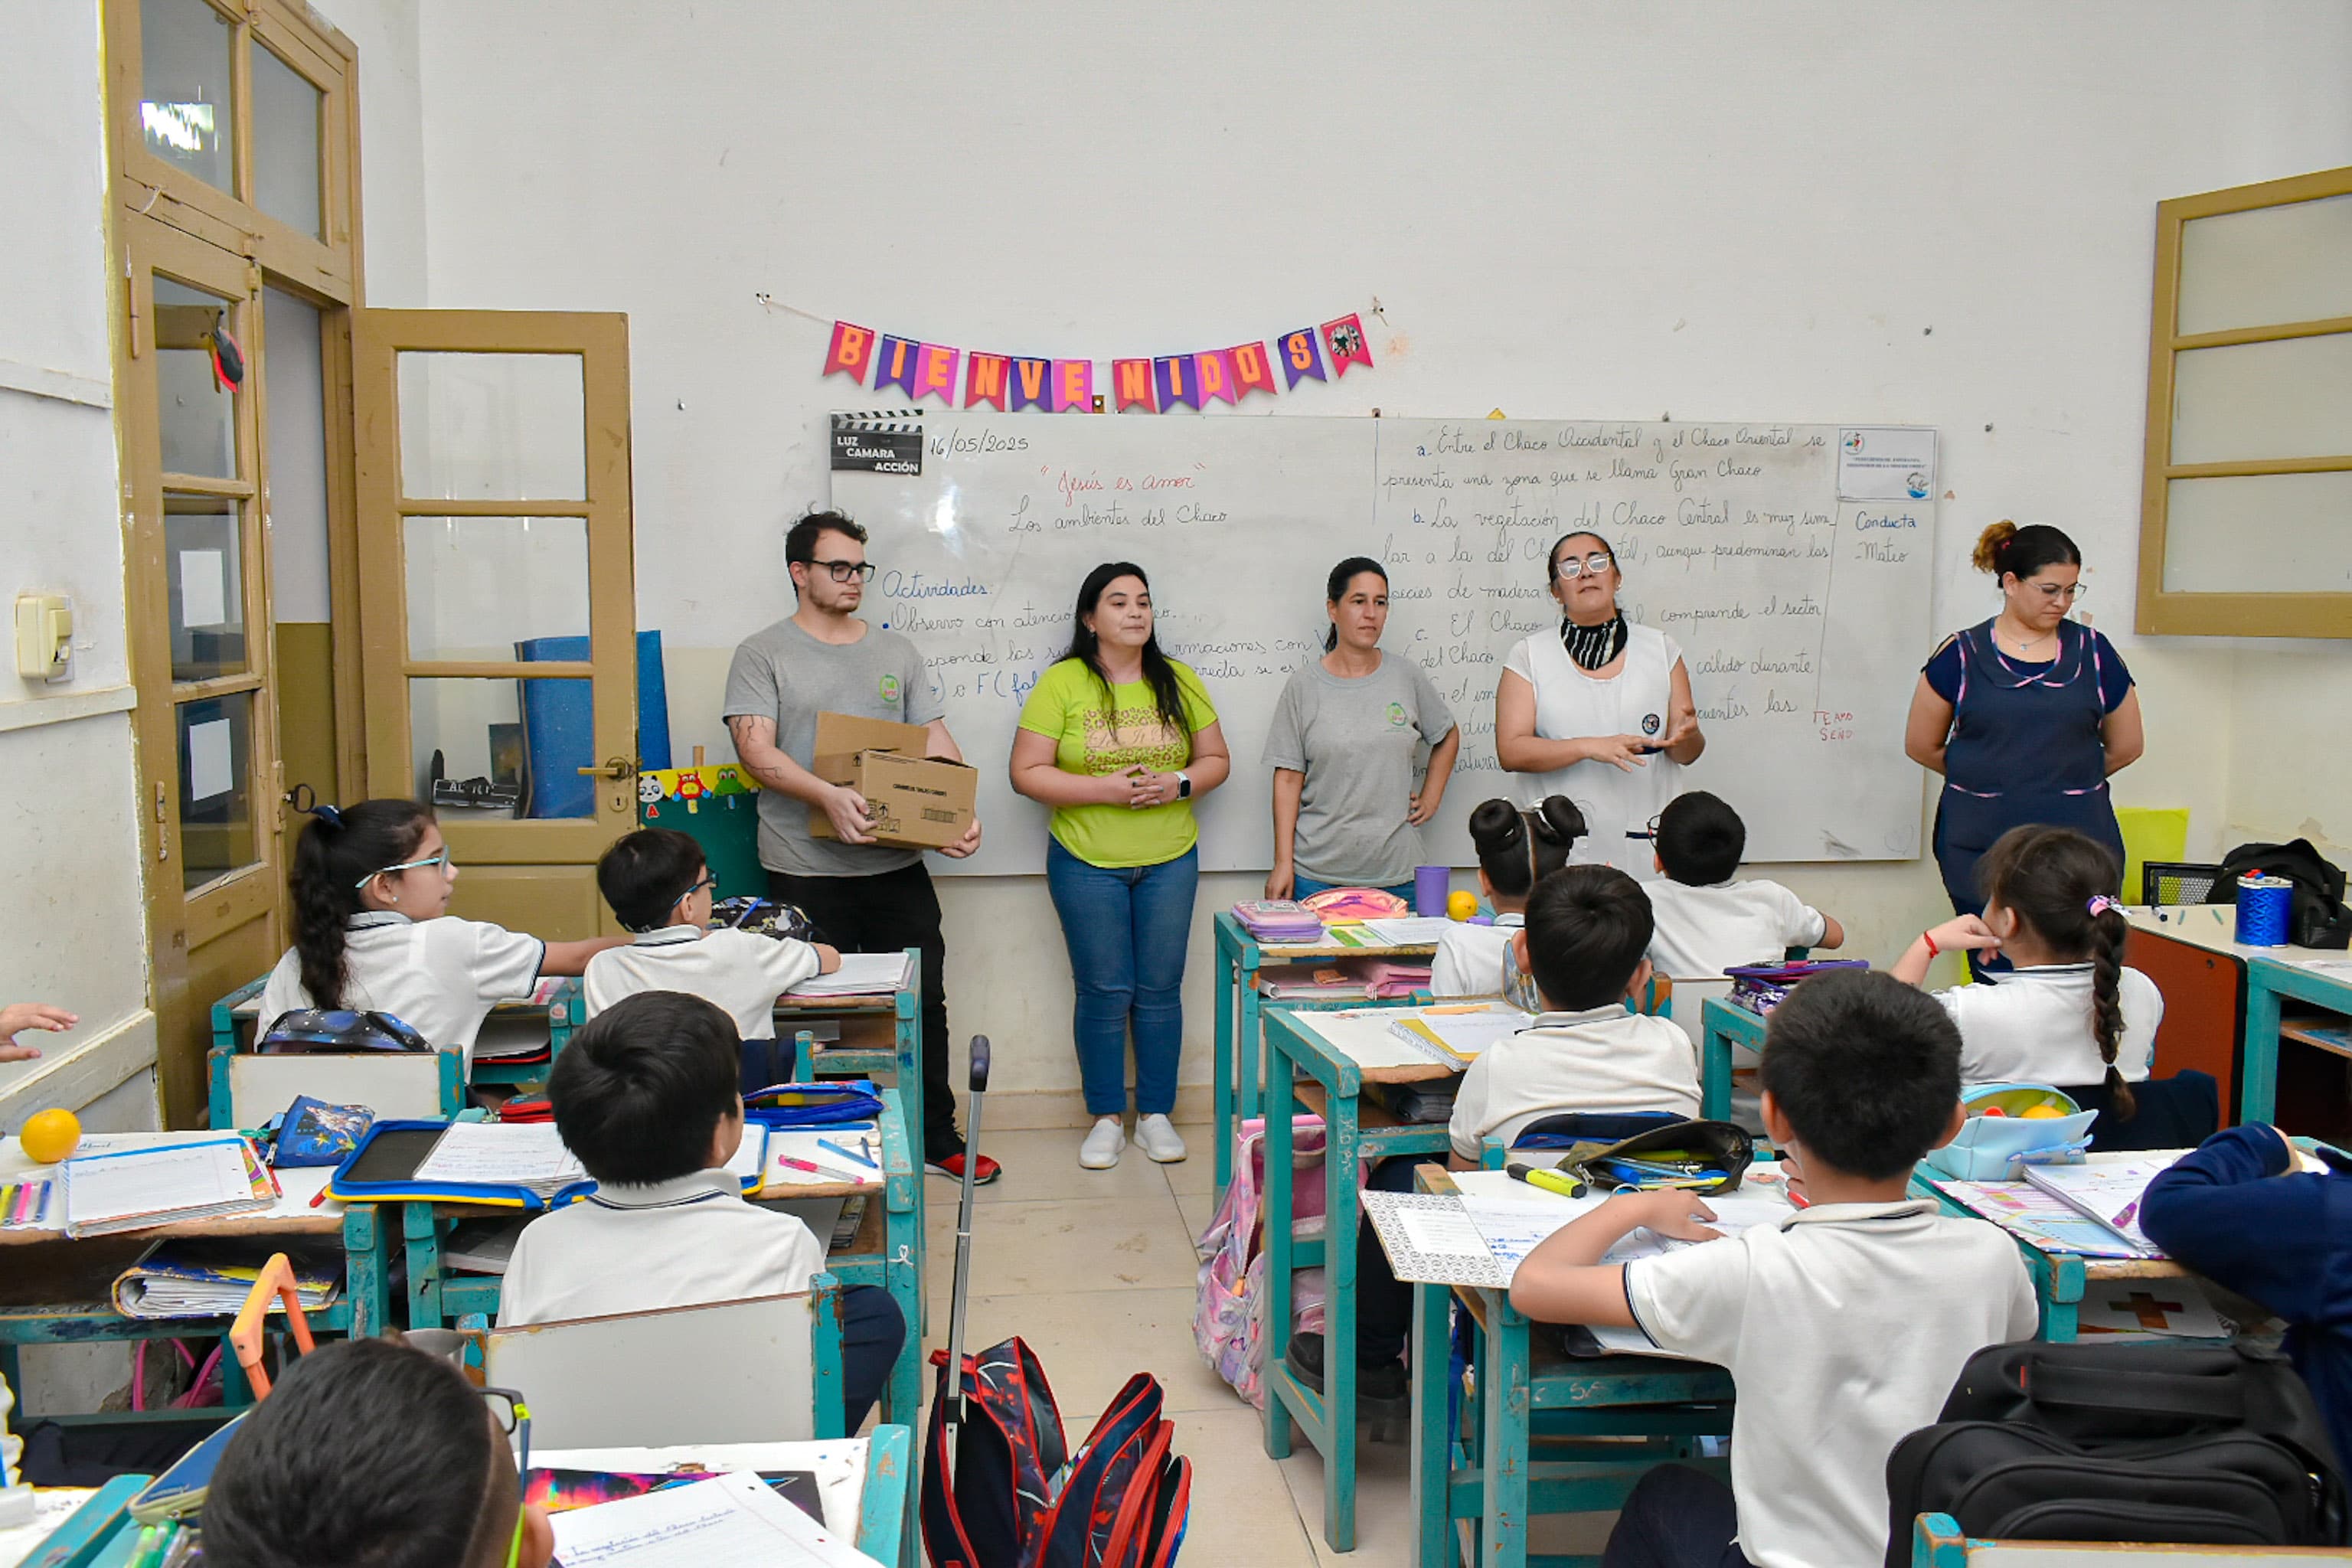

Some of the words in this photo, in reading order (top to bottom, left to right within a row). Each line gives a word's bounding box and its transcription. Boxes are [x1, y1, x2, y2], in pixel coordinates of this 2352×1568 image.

[837, 436, 859, 446] LUZ
[845, 447, 895, 459] CAMARA
[929, 427, 1030, 459] 16/05/2025
[1437, 425, 1476, 454] Entre
[1482, 430, 1496, 451] el
[1503, 430, 1548, 452] Chaco
[1557, 425, 1643, 448] Occidental
[1672, 429, 1684, 448] el
[1690, 427, 1730, 446] Chaco
[1736, 425, 1794, 446] Oriental
[1802, 434, 1826, 447] se
[875, 461, 919, 473] ACCIÓN
[1382, 464, 1456, 502] presenta
[1463, 475, 1494, 488] una
[1502, 475, 1541, 496] zona
[1550, 470, 1576, 494] que
[1586, 469, 1602, 481] se
[1609, 459, 1658, 480] llama
[1670, 459, 1708, 492] Gran
[1717, 458, 1762, 477] Chaco
[1115, 477, 1133, 491] es
[1009, 495, 1041, 532] Los
[1055, 500, 1131, 529] ambientes
[1142, 508, 1166, 526] del
[1177, 502, 1228, 524] Chaco
[1431, 498, 1459, 528] La
[1475, 496, 1560, 545] vegetación
[1573, 501, 1599, 528] del
[1612, 501, 1667, 526] Chaco
[1677, 498, 1729, 527] Central
[1743, 511, 1759, 525] es
[1763, 514, 1795, 536] muy
[1855, 511, 1916, 531] Conducta
[1380, 533, 1411, 564] lar
[1426, 552, 1436, 564] a
[1448, 535, 1473, 563] la
[1488, 537, 1514, 563] del
[1655, 546, 1706, 572] aunque
[1710, 541, 1802, 571] predominan
[1806, 535, 1829, 558] las
[882, 570, 995, 598] Actividades:
[1448, 573, 1473, 599] de
[1479, 580, 1540, 599] madera
[890, 602, 963, 632] Observo
[975, 618, 1004, 629] con
[1013, 600, 1076, 628] atenció
[1450, 610, 1474, 637] El
[1490, 610, 1543, 632] Chaco
[1661, 601, 1750, 636] comprende
[1758, 595, 1777, 616] el
[1782, 594, 1822, 616] sector
[925, 645, 998, 674] sponde
[1006, 640, 1034, 662] las
[1274, 639, 1313, 652] con
[1420, 645, 1443, 668] del
[1449, 640, 1494, 665] Chaco
[1194, 653, 1245, 678] rrecta
[1697, 649, 1746, 675] cálido
[1750, 648, 1814, 675] durante
[977, 672, 990, 694] F
[1451, 676, 1468, 704] el
[1697, 684, 1749, 720] cuentes
[1764, 689, 1798, 714] las
